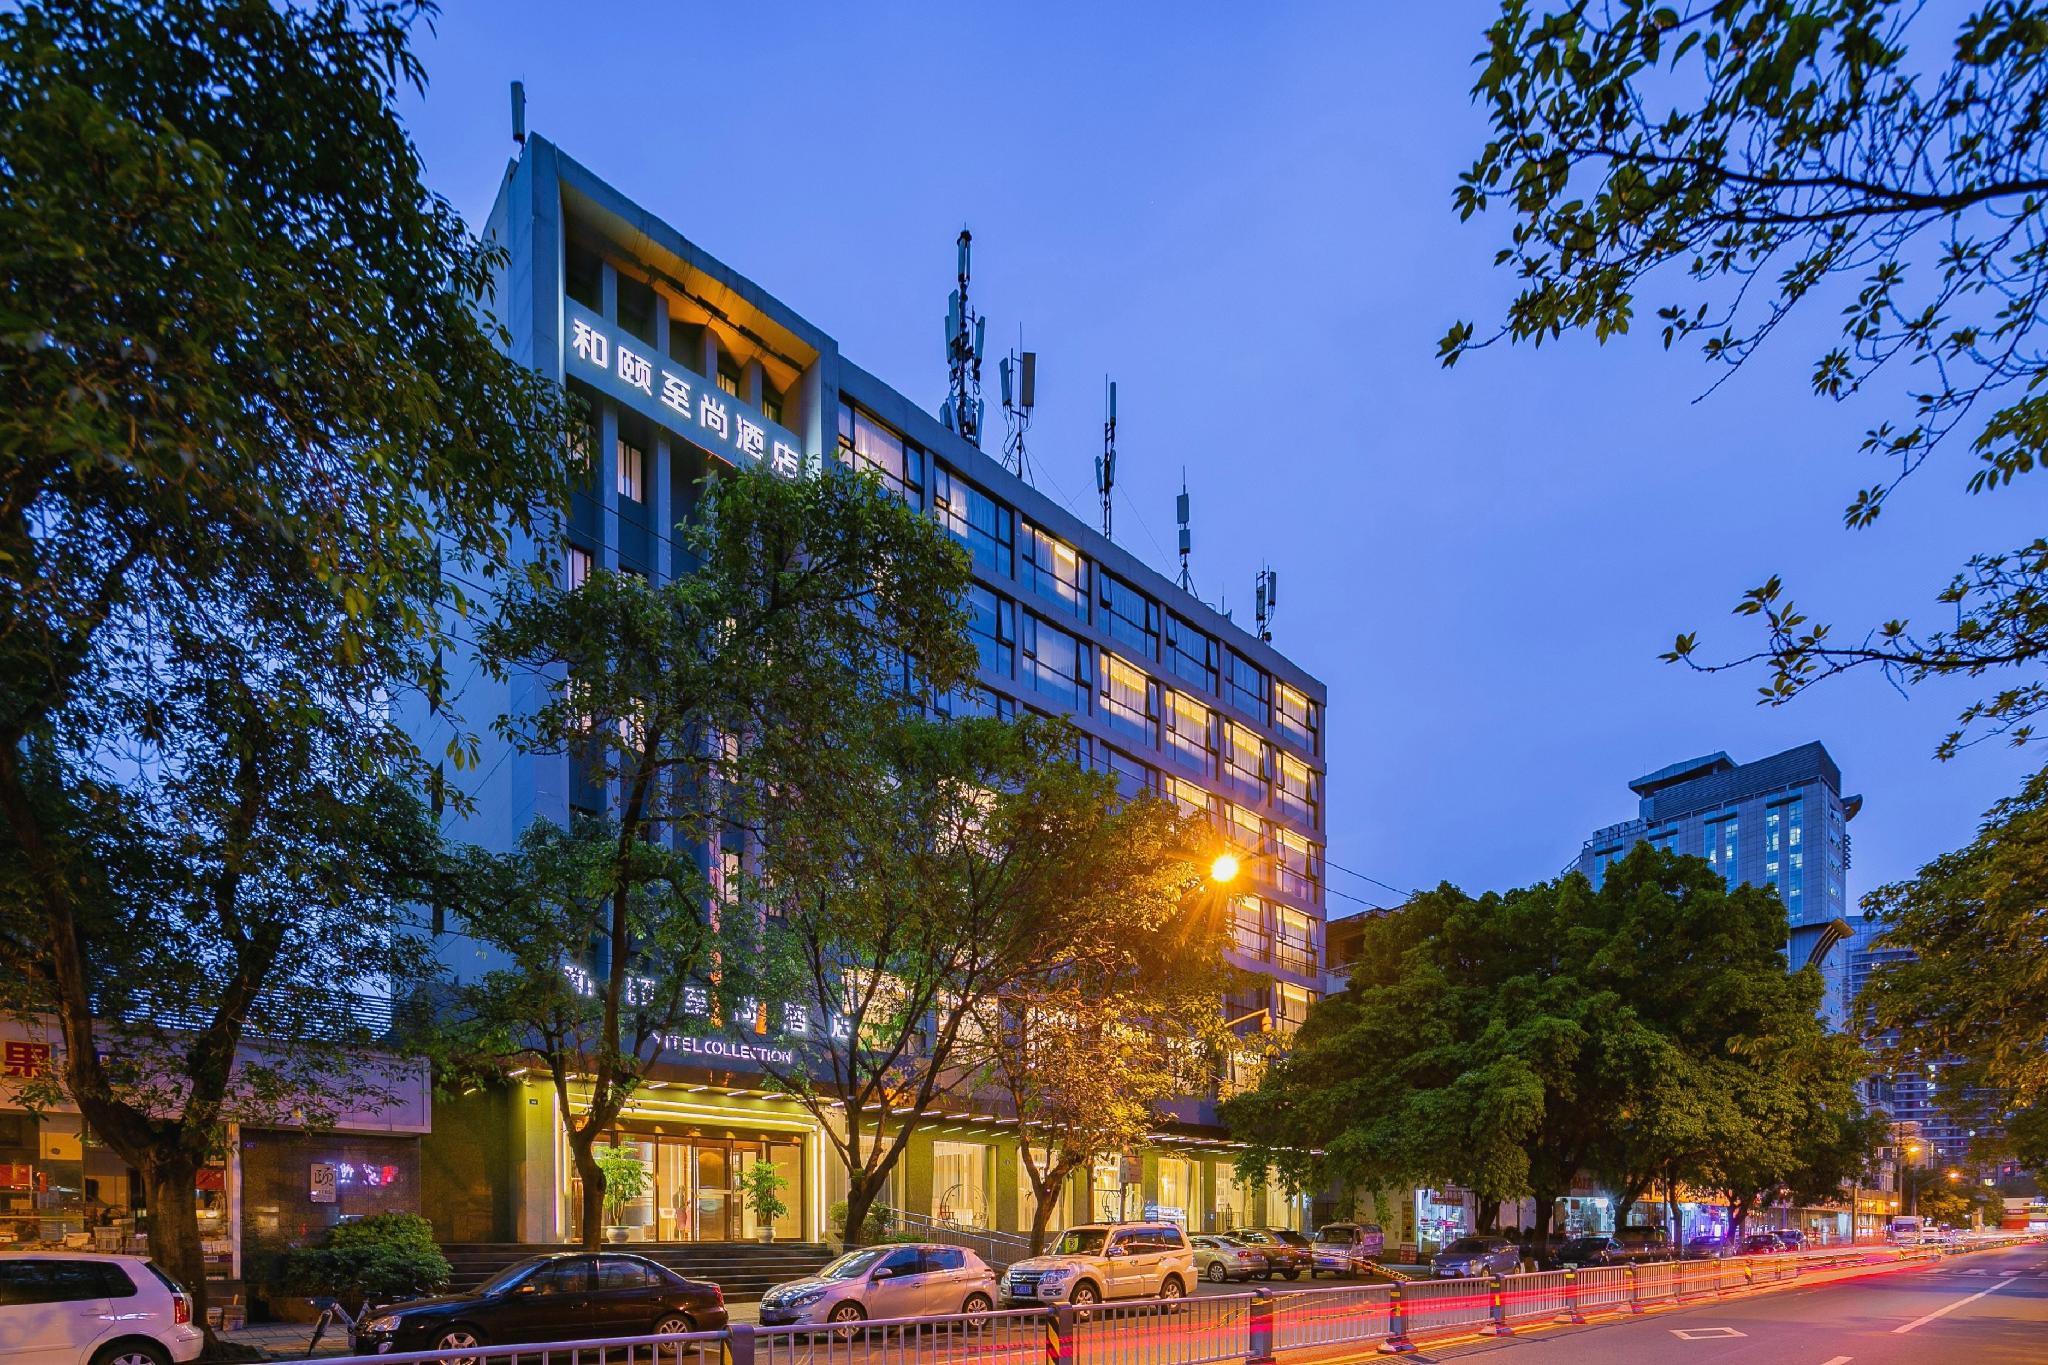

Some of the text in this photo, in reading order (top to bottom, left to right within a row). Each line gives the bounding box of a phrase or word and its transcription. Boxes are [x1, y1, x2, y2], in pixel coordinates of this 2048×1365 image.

[572, 318, 799, 479] 和颐至尚酒店
[704, 1041, 793, 1064] COLLECTION
